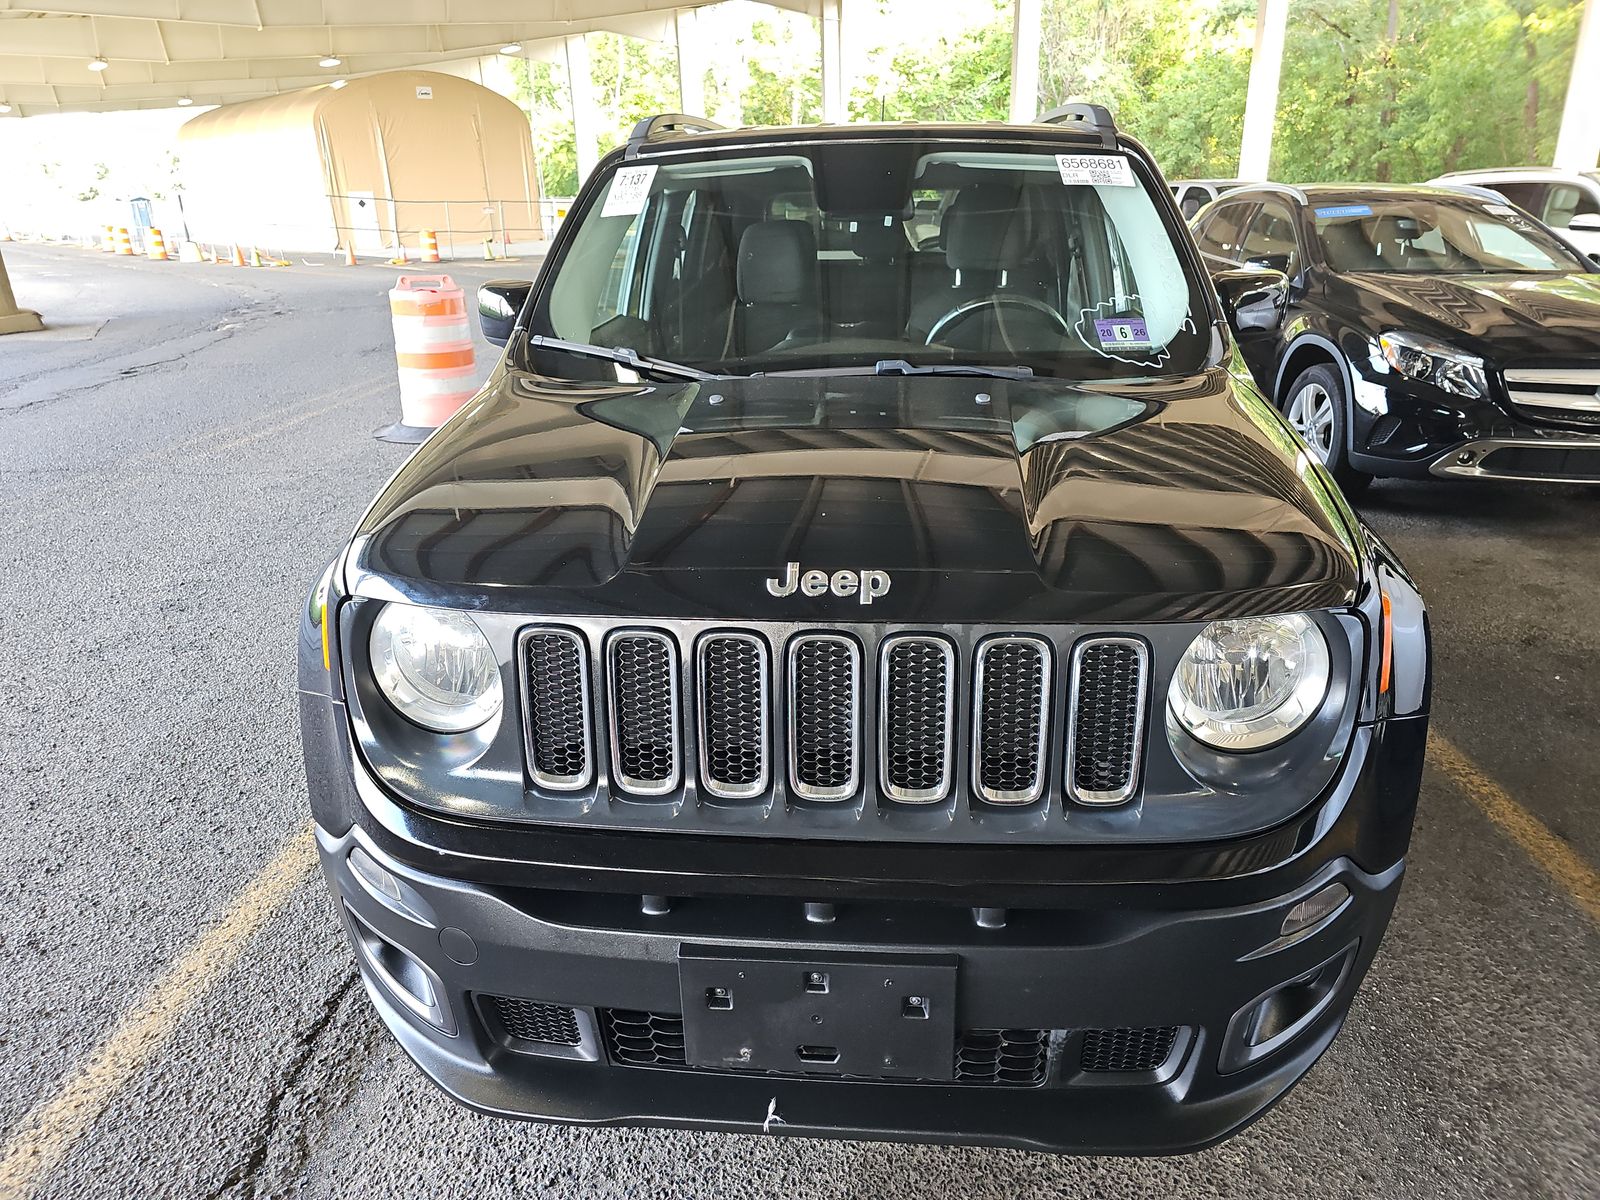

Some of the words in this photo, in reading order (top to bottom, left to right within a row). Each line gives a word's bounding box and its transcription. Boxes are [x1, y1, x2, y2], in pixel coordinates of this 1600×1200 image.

[1061, 158, 1123, 170] 6568681
[1120, 327, 1128, 338] 6
[766, 561, 892, 605] Jeep
